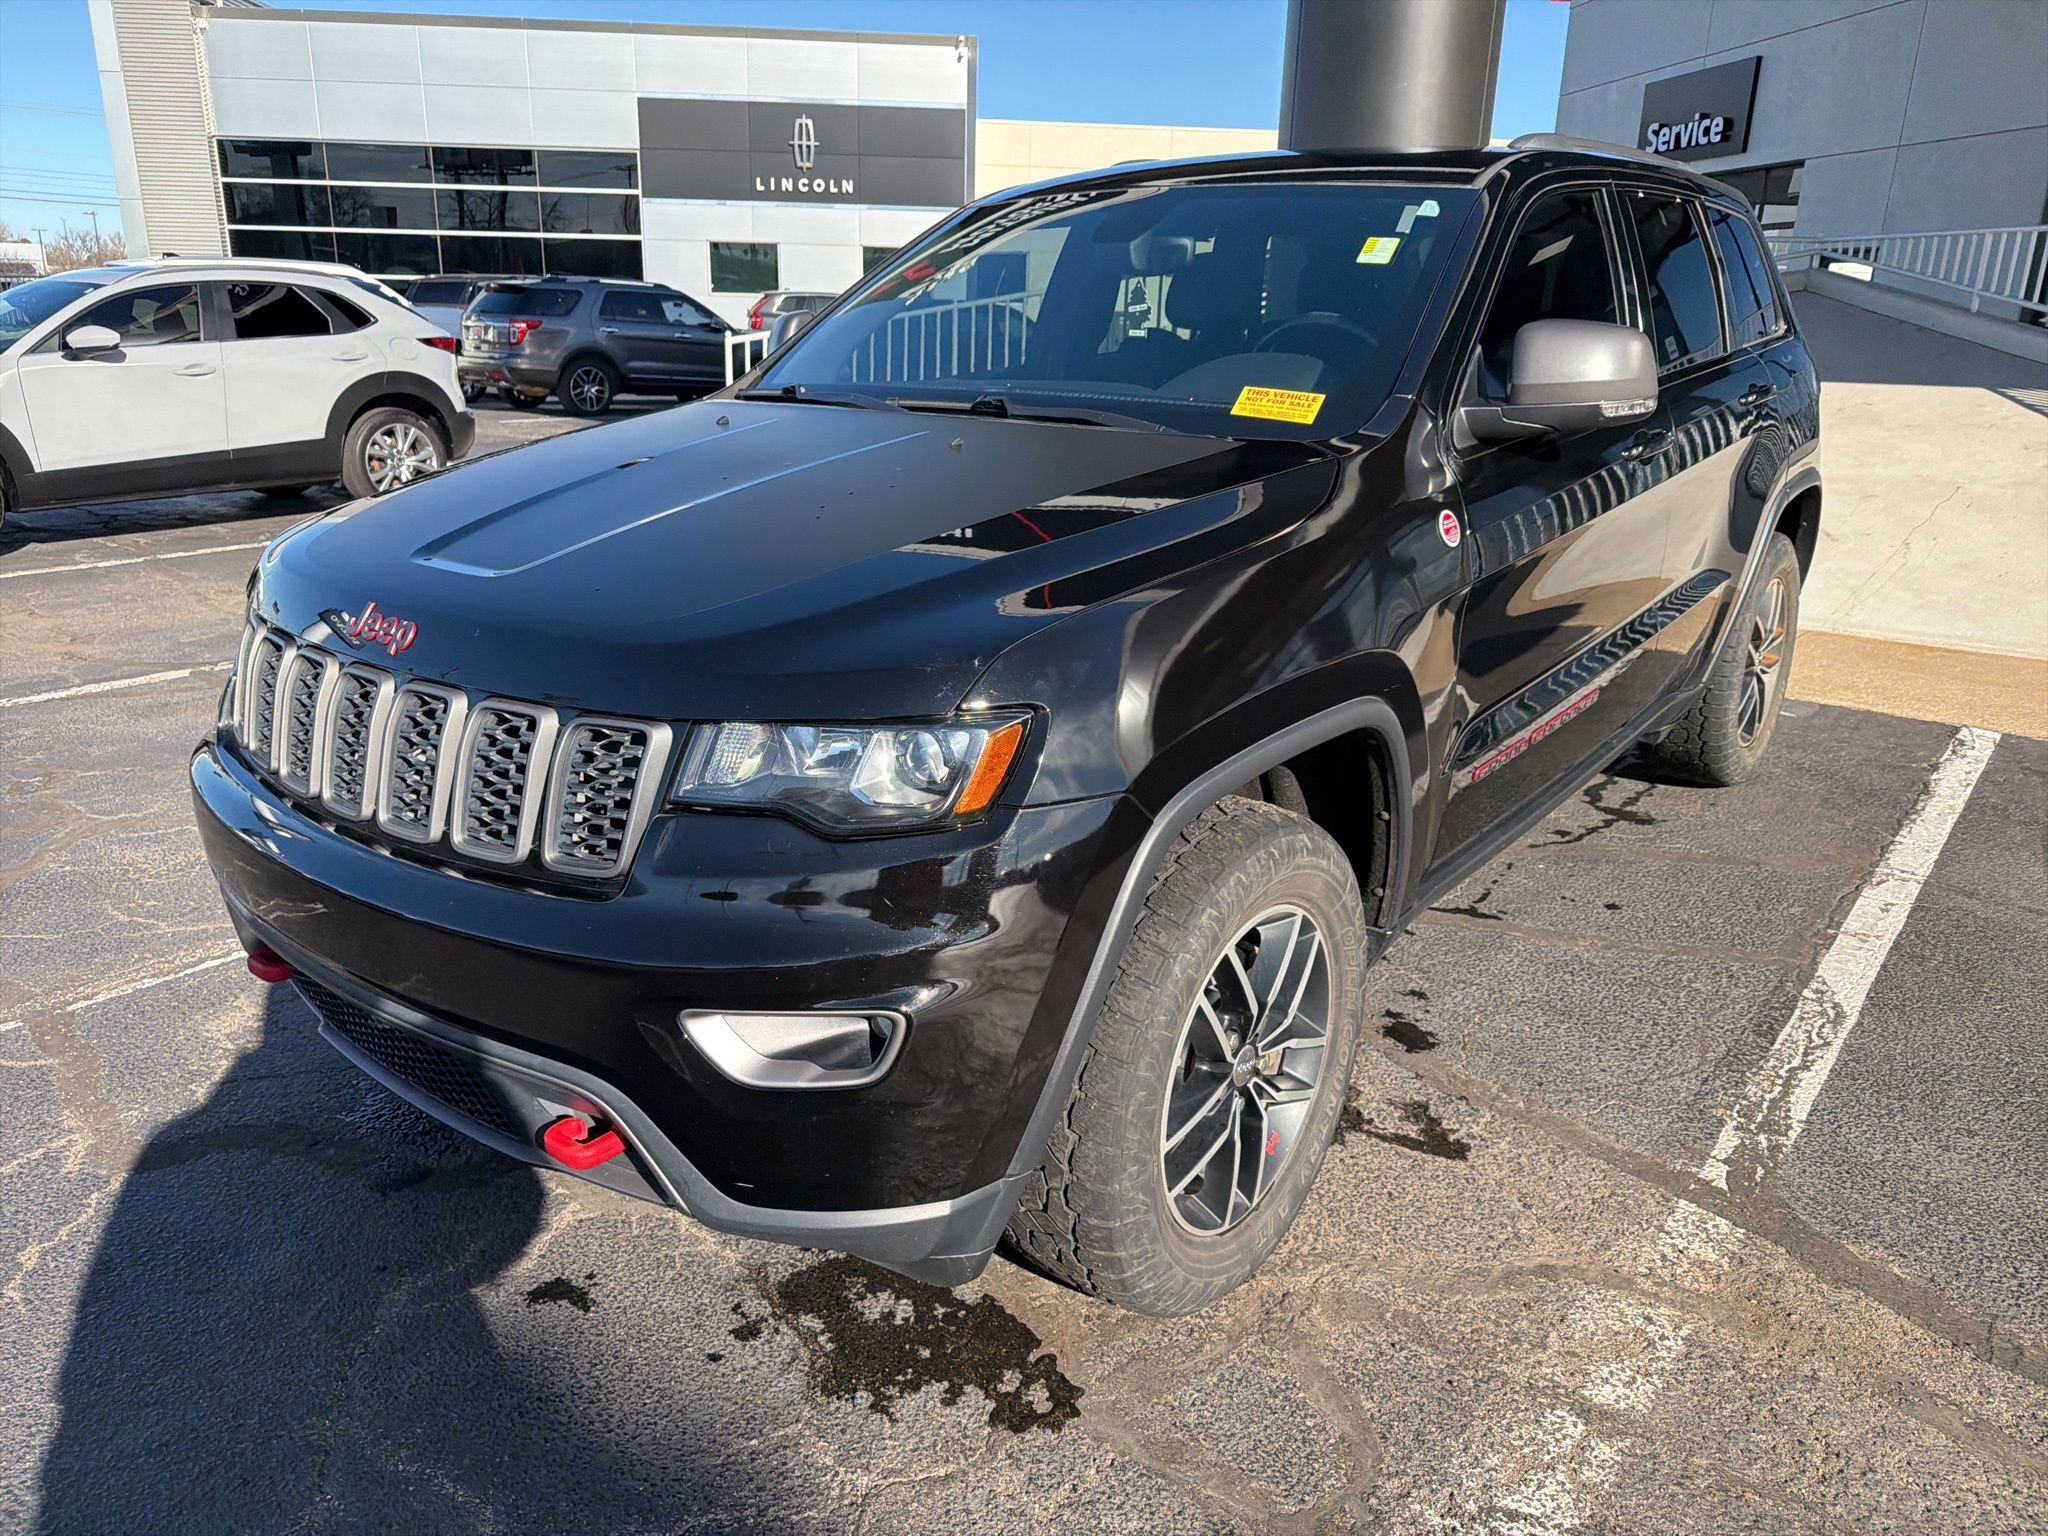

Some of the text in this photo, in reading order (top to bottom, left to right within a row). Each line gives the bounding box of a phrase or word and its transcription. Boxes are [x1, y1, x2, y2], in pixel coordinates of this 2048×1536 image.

[1646, 112, 1724, 153] Service
[755, 176, 854, 194] LINCOLN
[1246, 388, 1320, 403] THIS VEHICLE
[1266, 398, 1286, 406] FOR
[1288, 401, 1315, 409] SALE
[346, 601, 418, 657] Jeep
